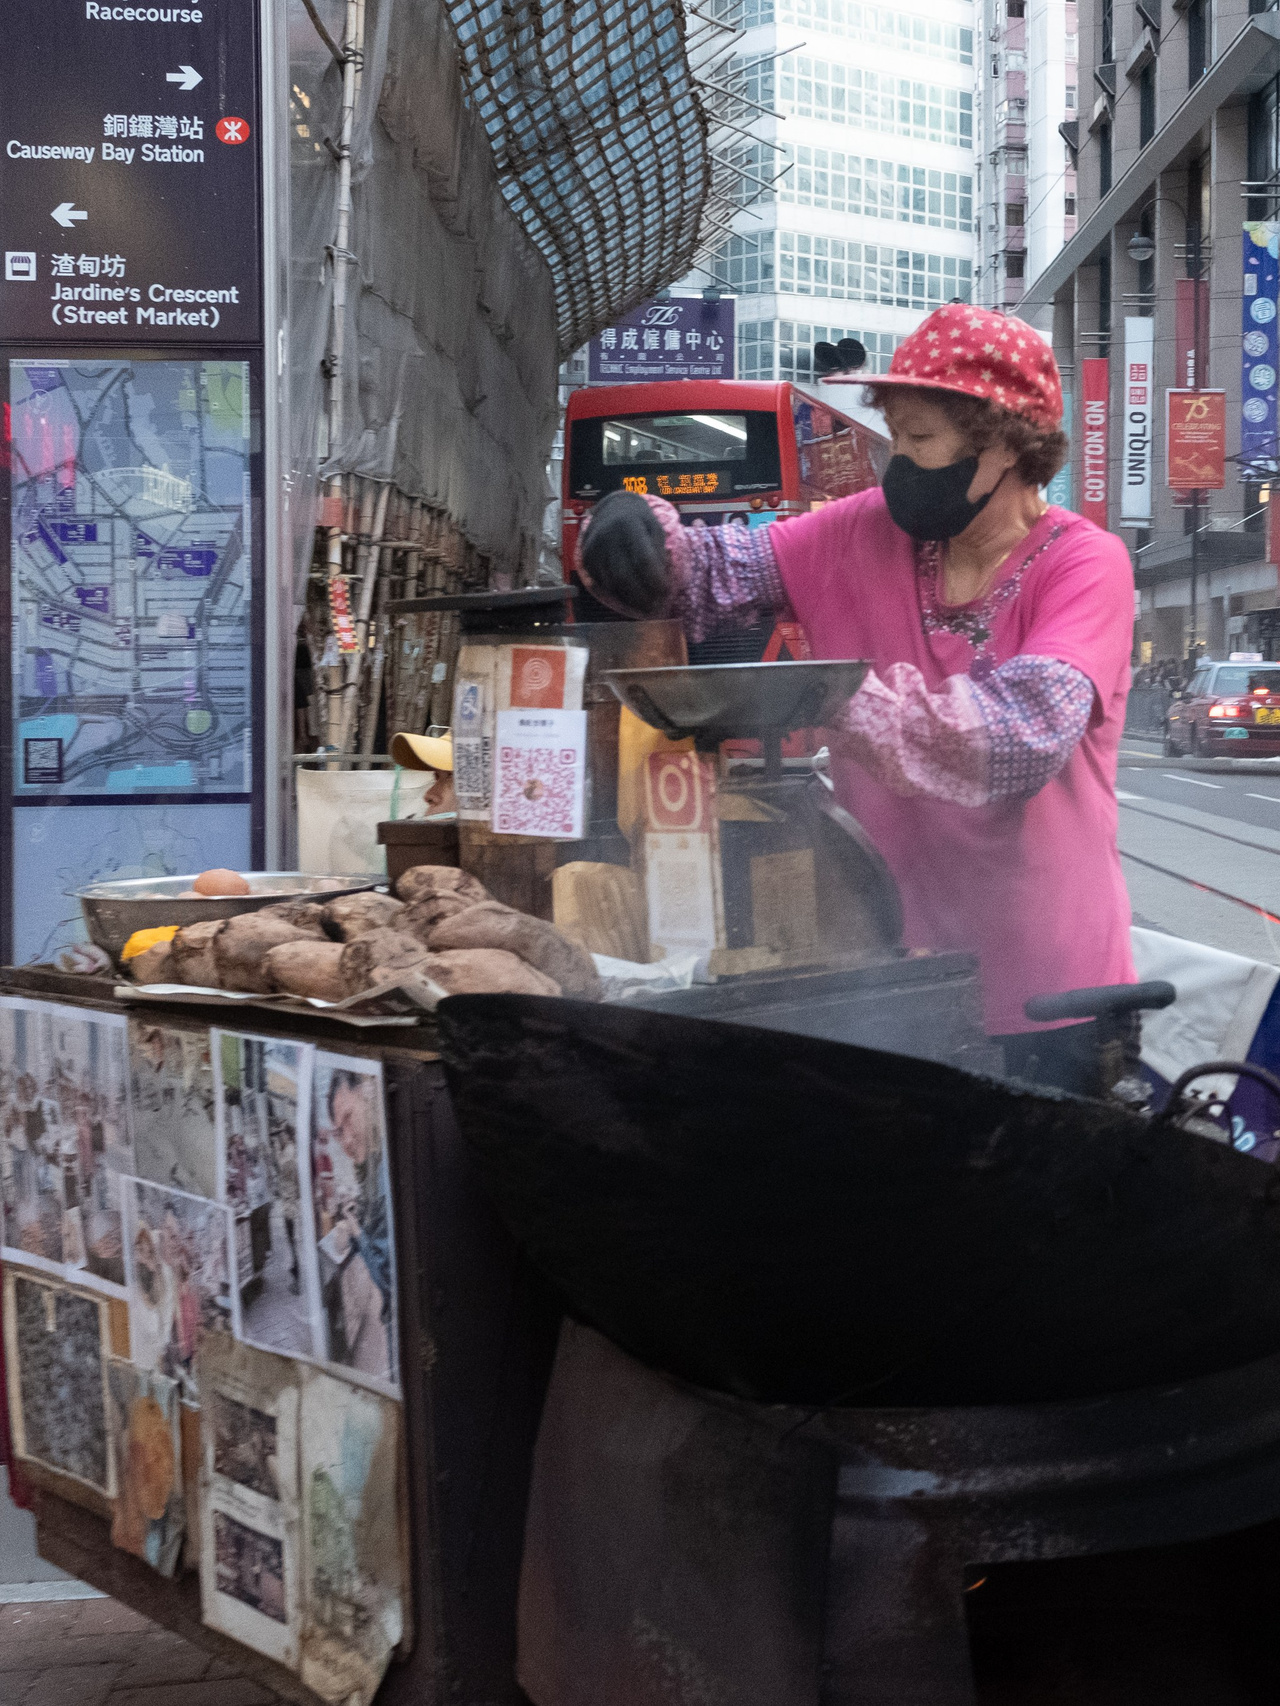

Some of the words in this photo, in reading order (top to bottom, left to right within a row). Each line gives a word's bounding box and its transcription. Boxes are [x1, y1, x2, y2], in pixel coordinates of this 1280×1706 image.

[86, 2, 203, 23] Racecourse
[103, 114, 204, 140] 銅鑼灣站
[6, 140, 95, 164] Causeway
[102, 143, 135, 164] Bay
[141, 144, 204, 163] Station
[51, 254, 126, 278] 渣甸坊
[51, 283, 140, 302] Jardine's
[149, 284, 239, 304] Crescent
[51, 303, 128, 325] (Street
[136, 307, 220, 328] Market)
[1128, 411, 1150, 486] UNIQLO
